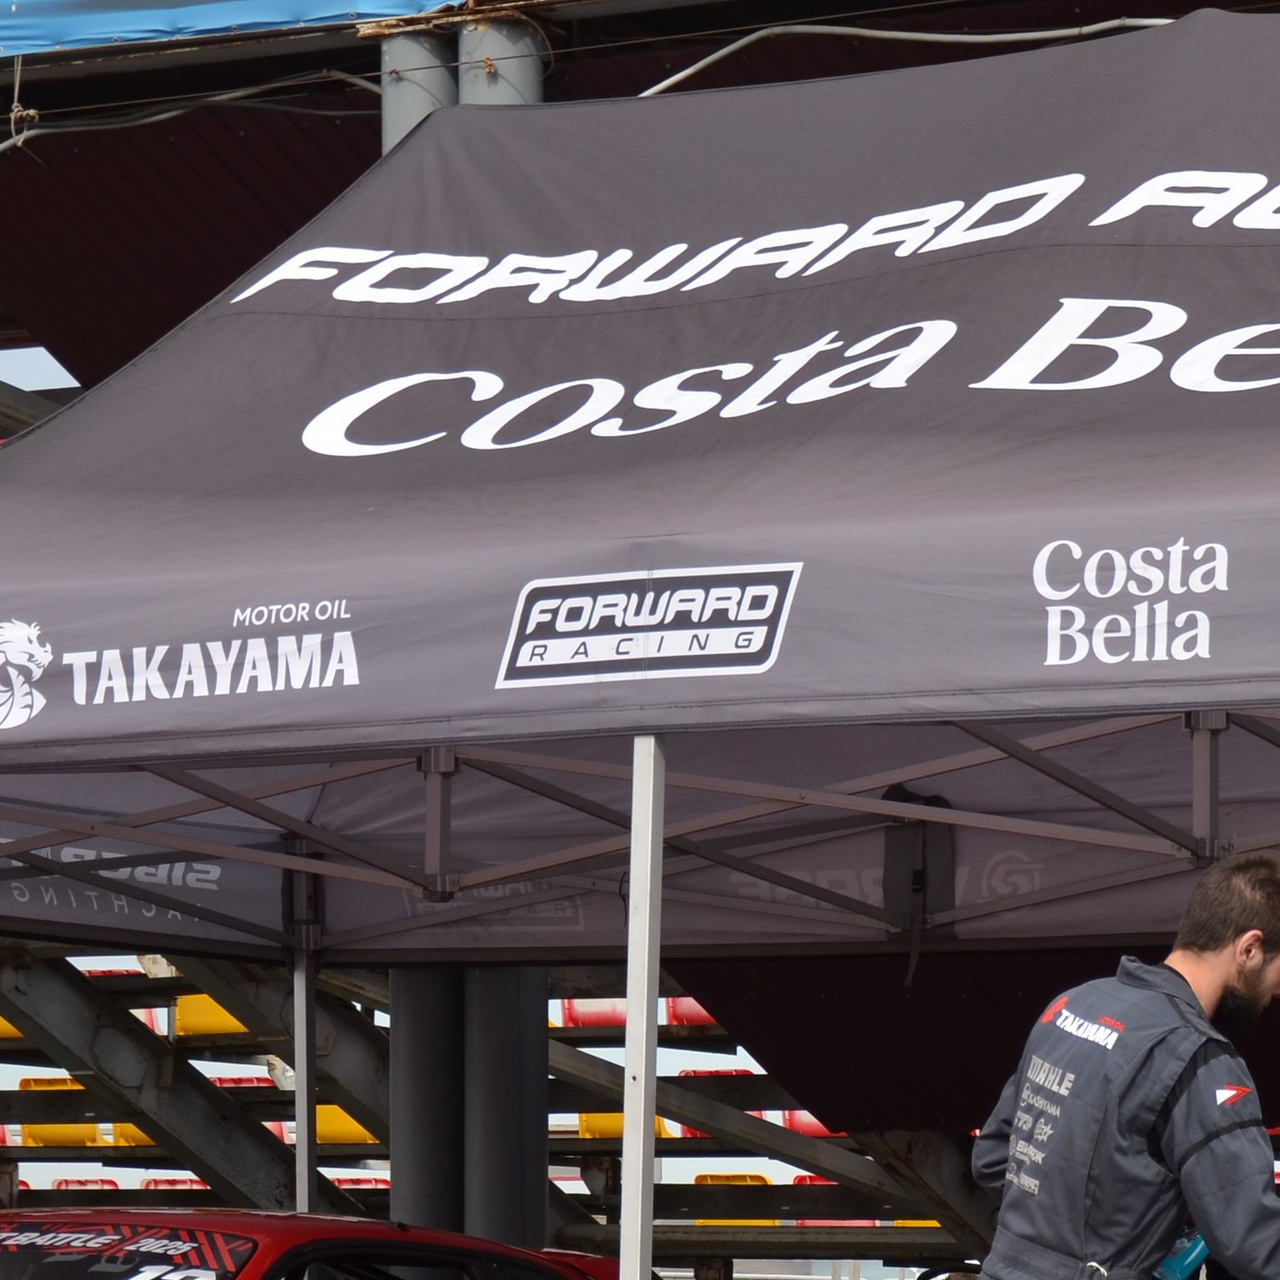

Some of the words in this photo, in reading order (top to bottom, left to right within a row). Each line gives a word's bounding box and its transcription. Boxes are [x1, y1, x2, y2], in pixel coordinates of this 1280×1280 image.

[230, 173, 1085, 304] FORWARD
[301, 320, 958, 457] Costa
[1032, 536, 1229, 600] Costa
[233, 602, 308, 627] MOTOR
[314, 599, 351, 620] OIL
[525, 585, 778, 634] FORWARD
[1044, 600, 1211, 667] Bella
[62, 631, 360, 705] TAKAYAMA
[529, 631, 754, 662] RACING
[1027, 1055, 1075, 1096] MAHLE
[1, 1232, 122, 1248] BATTLE
[124, 1239, 198, 1255] 2025
